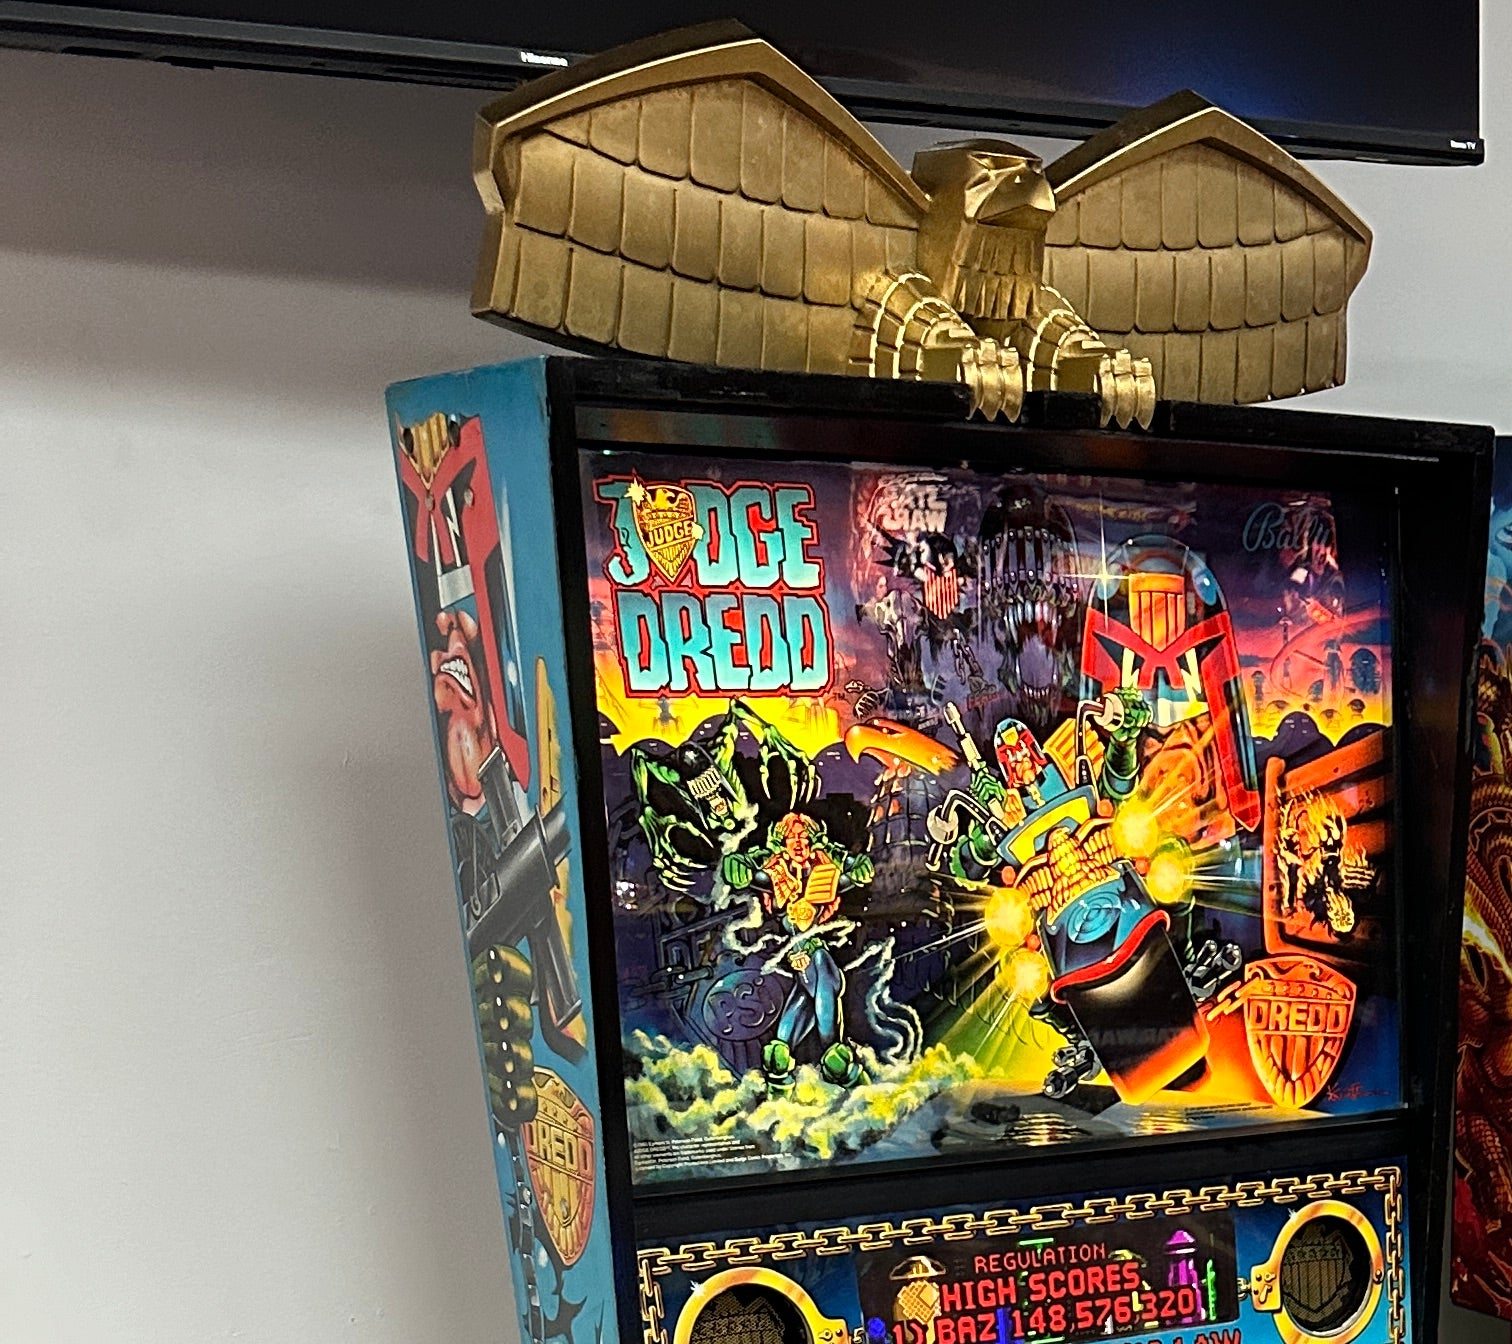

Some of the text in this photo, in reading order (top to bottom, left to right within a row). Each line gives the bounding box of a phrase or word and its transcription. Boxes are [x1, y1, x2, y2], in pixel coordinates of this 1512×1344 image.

[647, 520, 693, 547] JUDGE
[616, 590, 831, 692] DREDD
[1249, 1000, 1349, 1034] DREDD
[528, 1121, 594, 1178] DREDD
[973, 1242, 1107, 1274] REGULATION
[940, 1261, 1141, 1313] HIGH SCORES
[1011, 1285, 1197, 1339] 148,576,320
